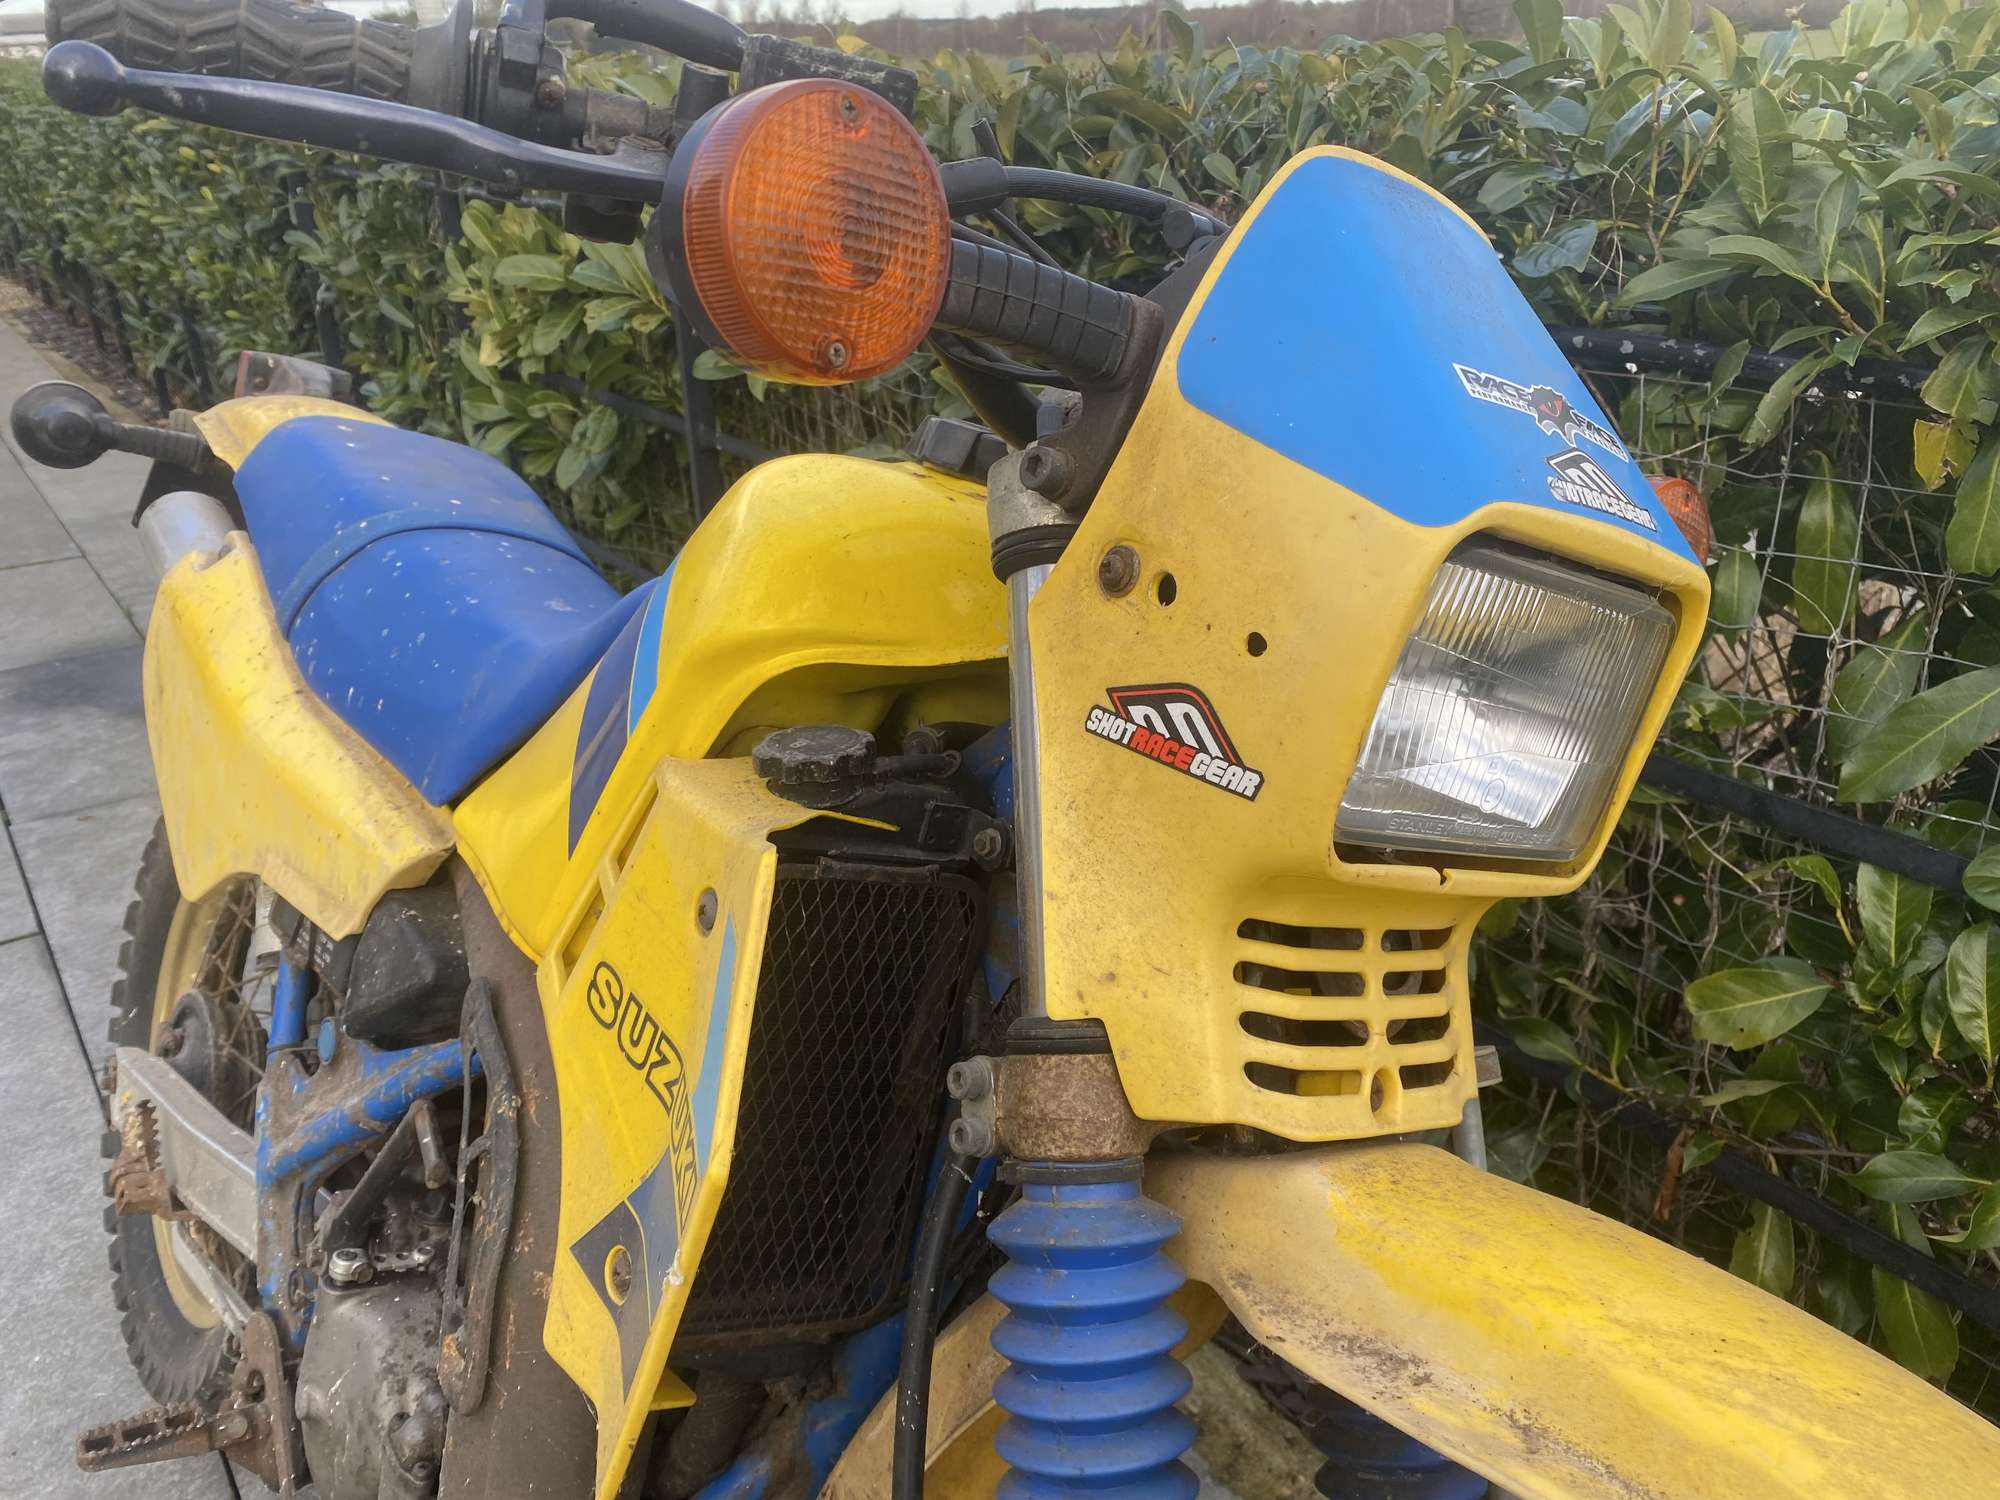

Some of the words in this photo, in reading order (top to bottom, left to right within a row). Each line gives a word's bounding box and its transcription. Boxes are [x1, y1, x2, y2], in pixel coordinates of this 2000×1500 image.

[1459, 367, 1533, 403] RACE
[1388, 817, 1453, 838] STANLEY
[587, 960, 698, 1234] SUZUKI
